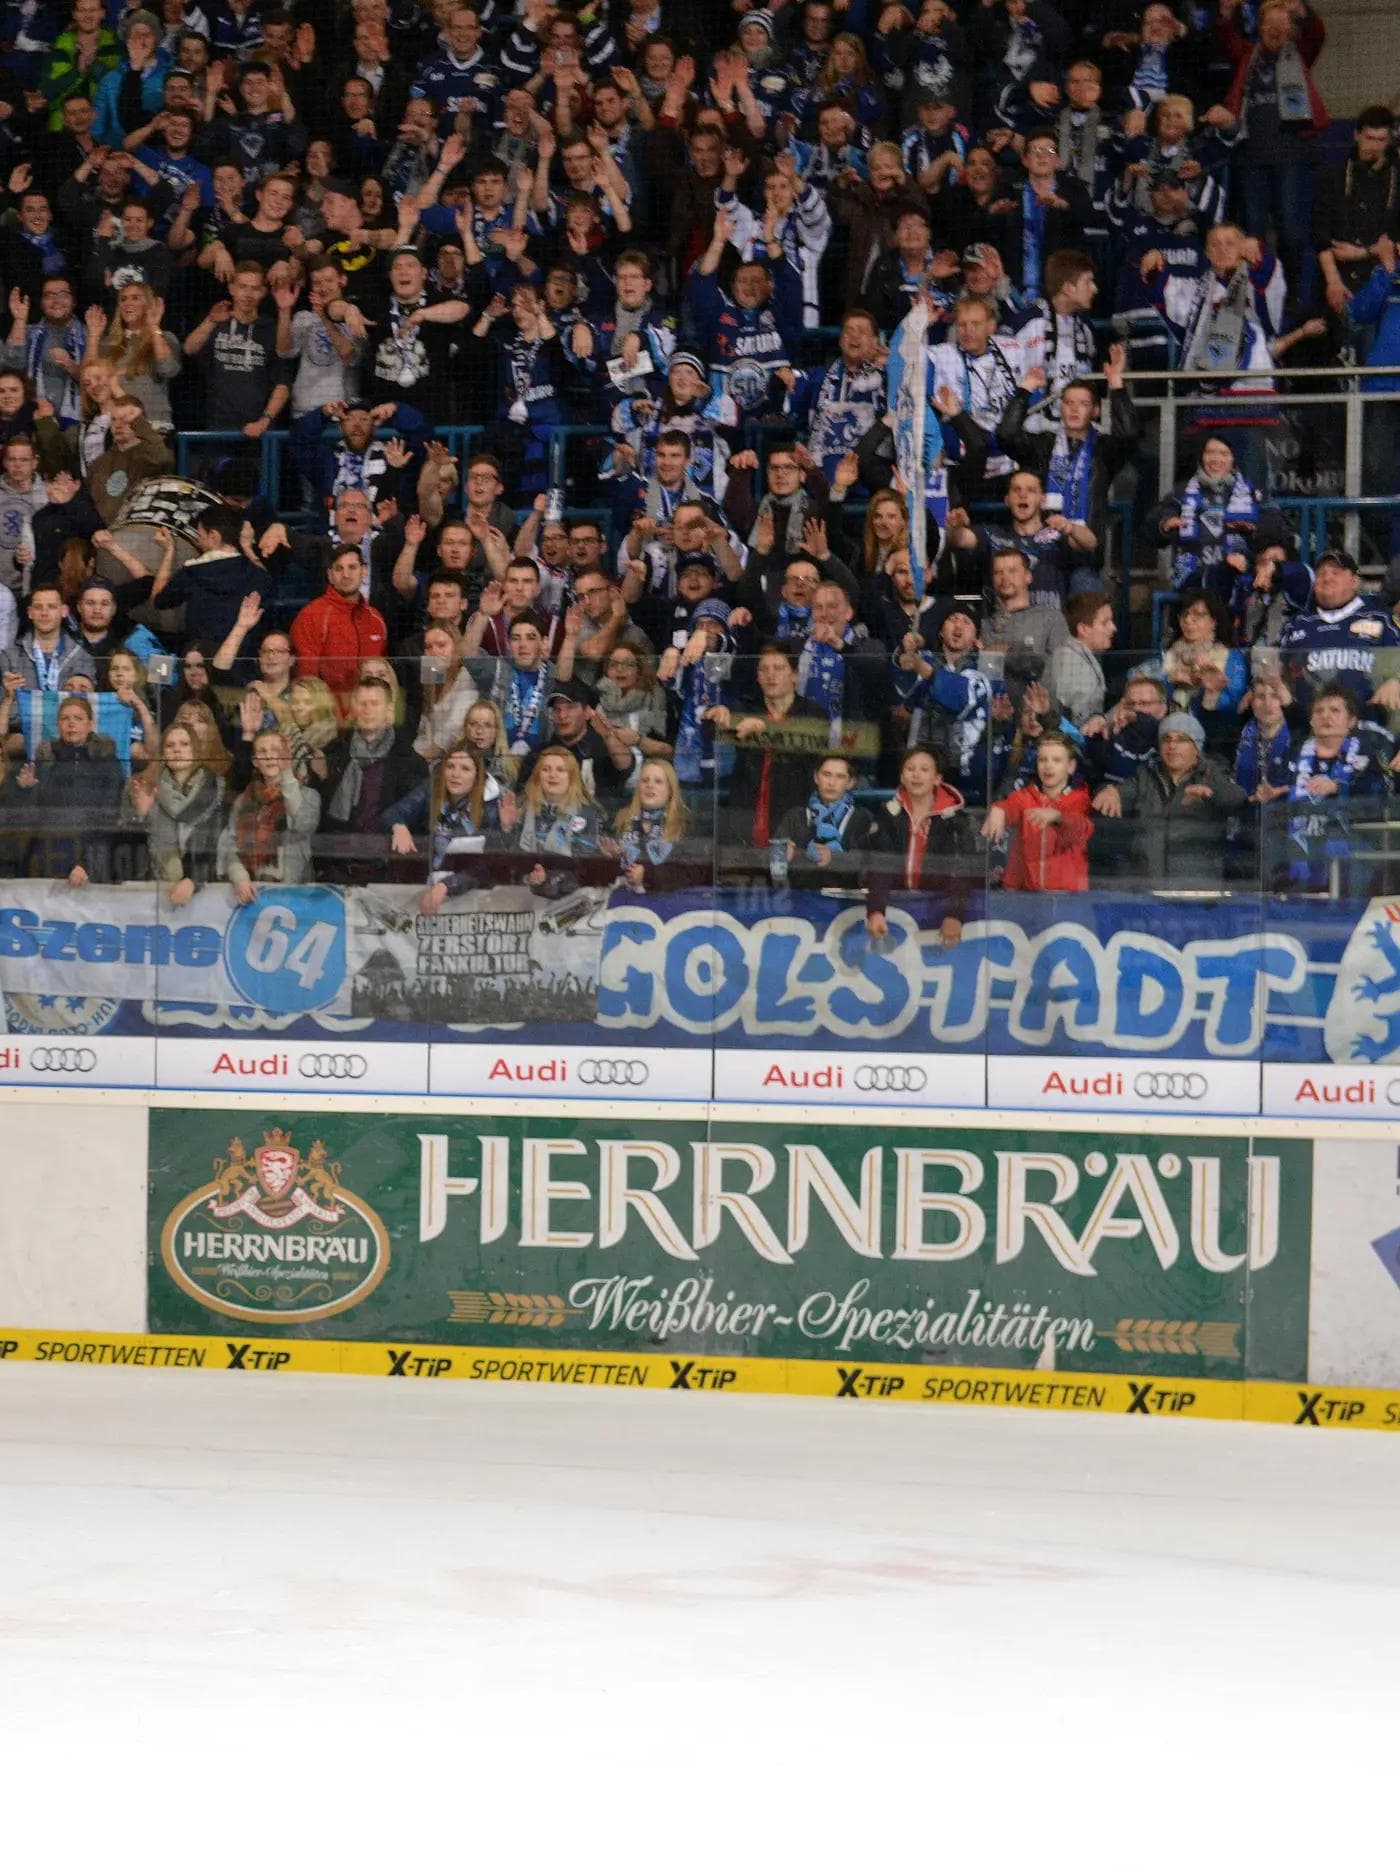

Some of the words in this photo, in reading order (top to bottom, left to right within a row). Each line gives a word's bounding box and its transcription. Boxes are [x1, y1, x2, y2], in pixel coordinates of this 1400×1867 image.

[244, 904, 339, 990] 64
[213, 1053, 288, 1075] Audi
[489, 1058, 567, 1081] Audi
[764, 1065, 843, 1088] Audi
[1043, 1072, 1123, 1095] Audi
[1296, 1079, 1375, 1103] Audi
[416, 1133, 1281, 1277] HERRNBRÄU
[183, 1231, 369, 1265] HERRNBRÄU
[35, 1341, 207, 1370] SPORTWETTEN
[469, 1359, 649, 1387] SPORTWETTEN
[921, 1377, 1107, 1408] SPORTWETTEN
